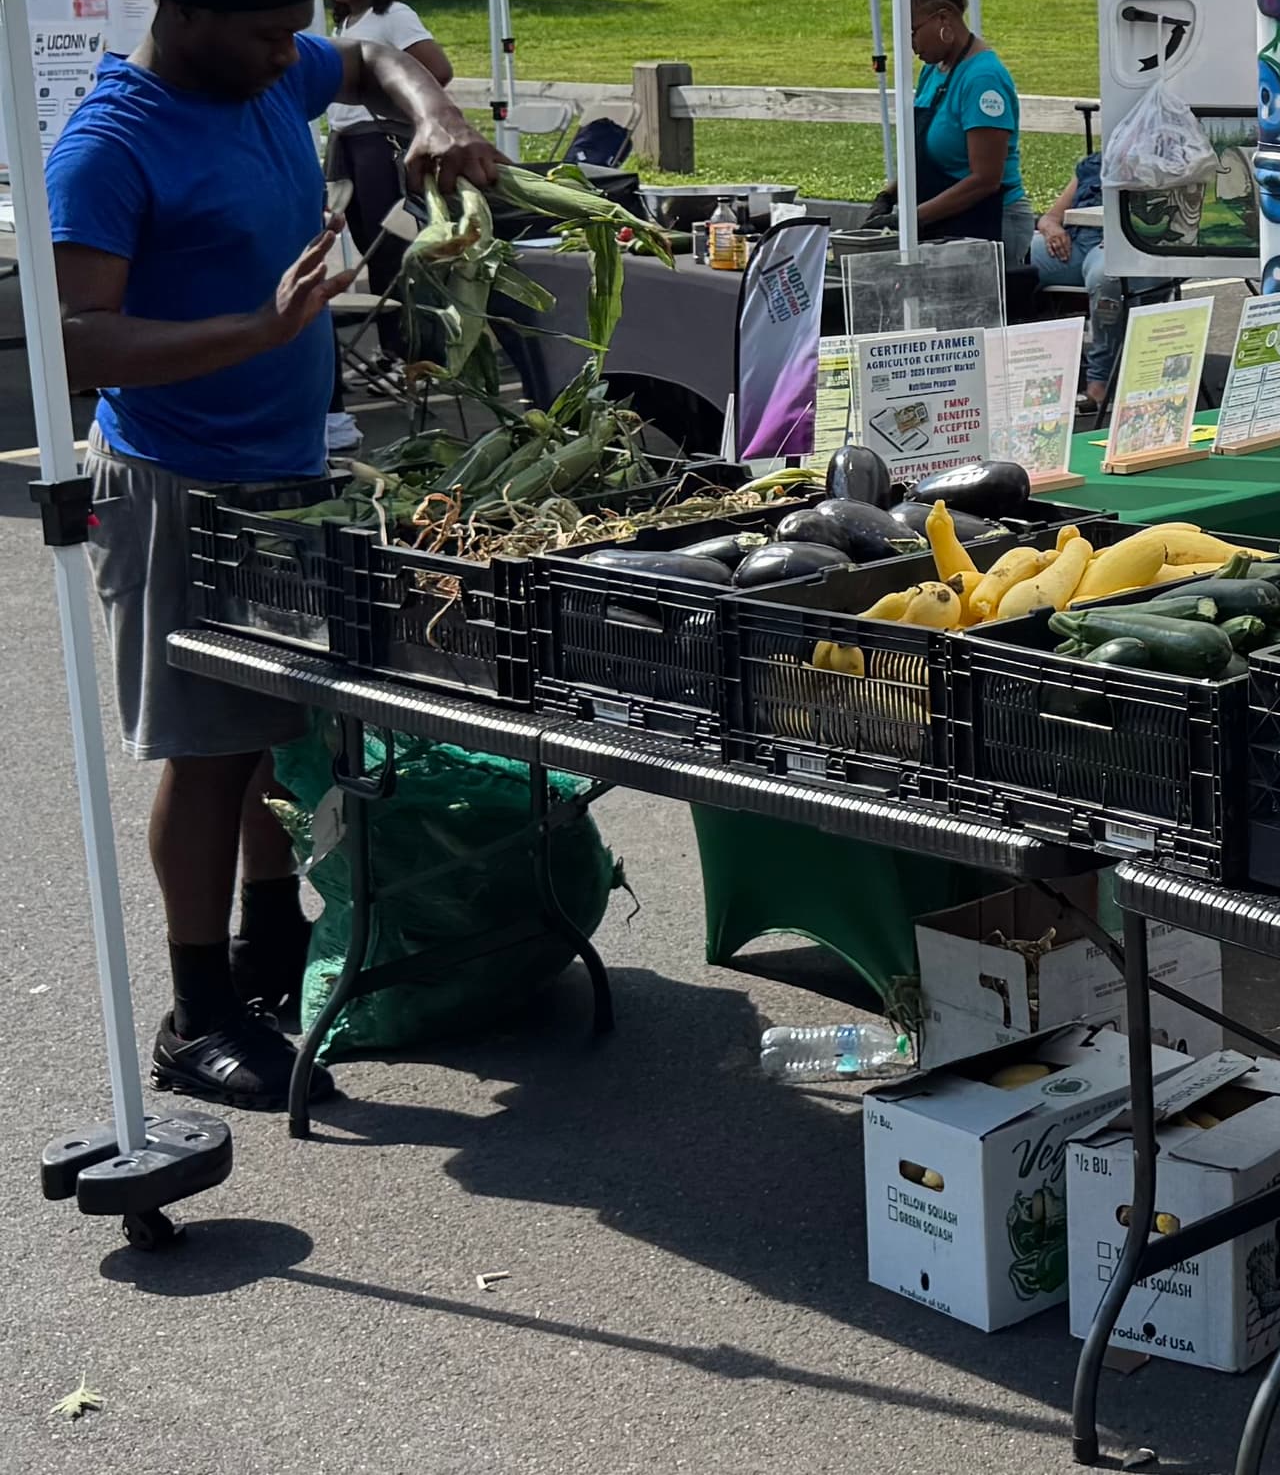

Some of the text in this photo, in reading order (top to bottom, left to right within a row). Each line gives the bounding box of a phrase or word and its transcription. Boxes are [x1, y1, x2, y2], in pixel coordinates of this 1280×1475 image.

[47, 33, 88, 51] UCONN
[763, 274, 792, 322] ASCEND
[786, 263, 812, 312] NORTH
[869, 336, 976, 357] CERTIFIED FARMER
[866, 349, 980, 371] AGRICULTOR CERTIFICADO
[943, 397, 970, 409] FMNP
[937, 408, 981, 422] BENEFITS
[933, 420, 980, 435] ACCEPTED
[946, 433, 971, 445] HERE
[1075, 1153, 1112, 1177] 1/2 BU.
[898, 1191, 958, 1226] YELLOW SQUASH
[898, 1211, 953, 1244] GREEN SQUASH
[1150, 1279, 1192, 1298] SQUASH
[1112, 1328, 1196, 1354] roduce of USA
